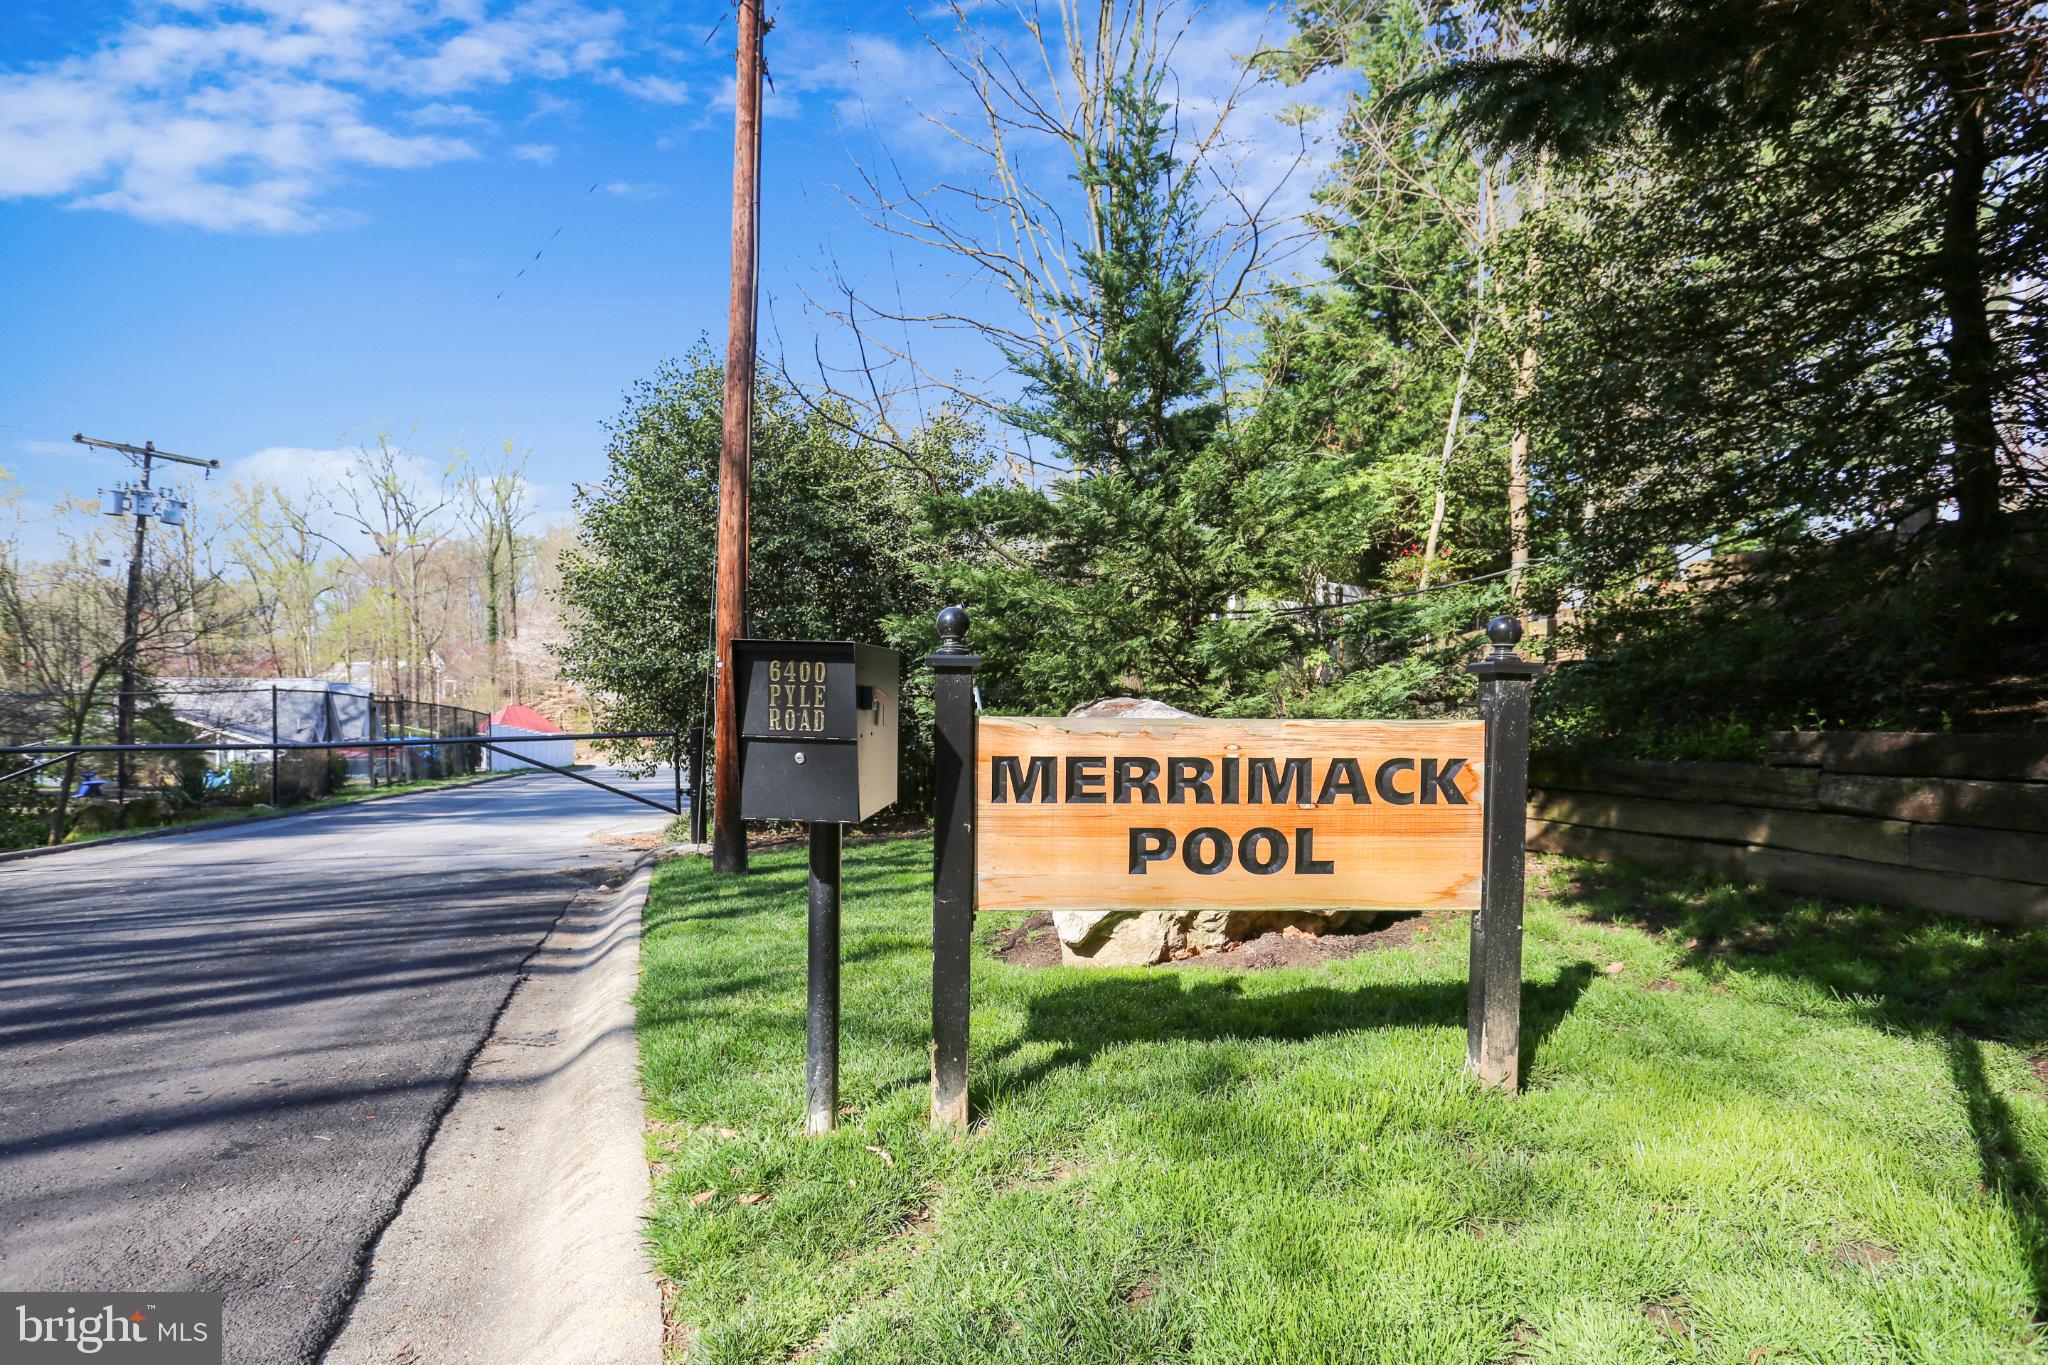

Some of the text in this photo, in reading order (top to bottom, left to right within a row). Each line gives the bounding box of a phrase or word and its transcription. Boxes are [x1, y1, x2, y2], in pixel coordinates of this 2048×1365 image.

[768, 660, 826, 683] 6400
[768, 684, 826, 708] PYLE
[768, 708, 825, 732] ROAD
[991, 756, 1469, 805] MERRIMACK
[1128, 827, 1335, 875] POOL
